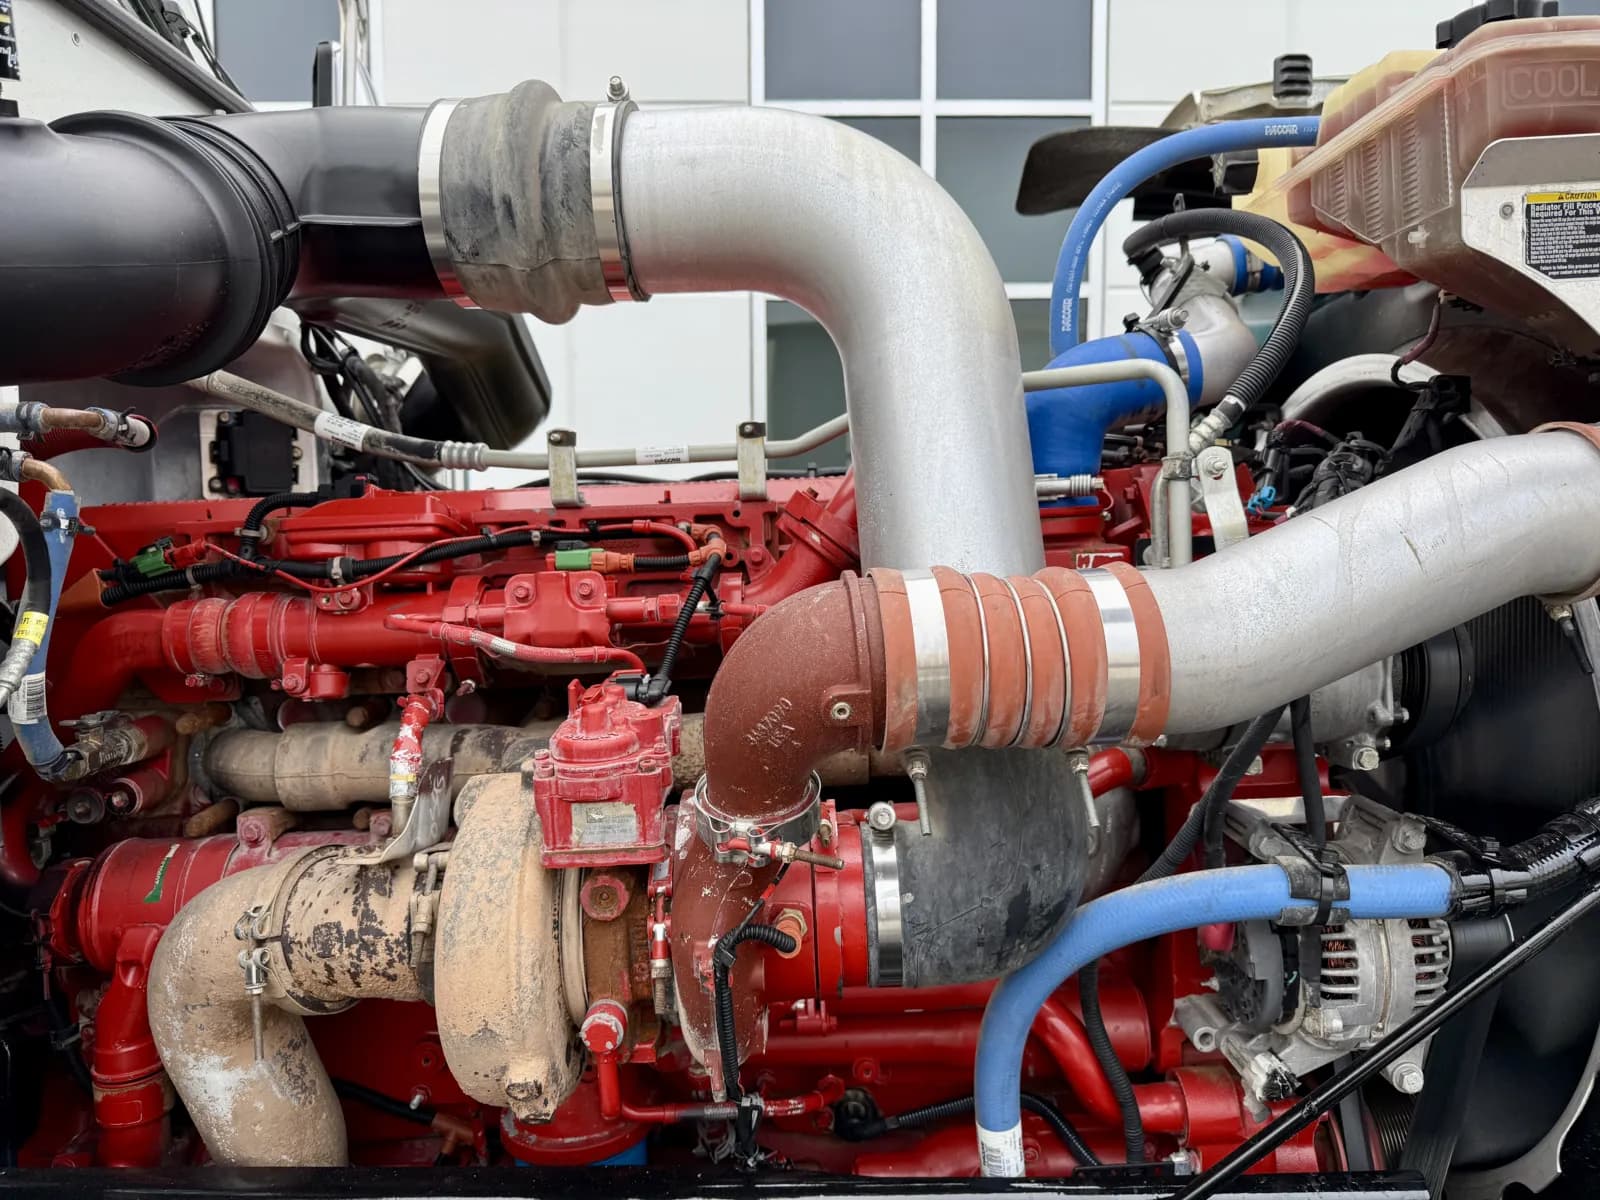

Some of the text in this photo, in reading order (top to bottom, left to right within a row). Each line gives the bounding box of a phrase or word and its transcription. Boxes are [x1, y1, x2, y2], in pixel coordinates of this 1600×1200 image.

[1510, 65, 1598, 99] COOL
[1565, 192, 1598, 200] CAUTION
[1531, 204, 1561, 212] Radiator
[1531, 210, 1563, 218] Required
